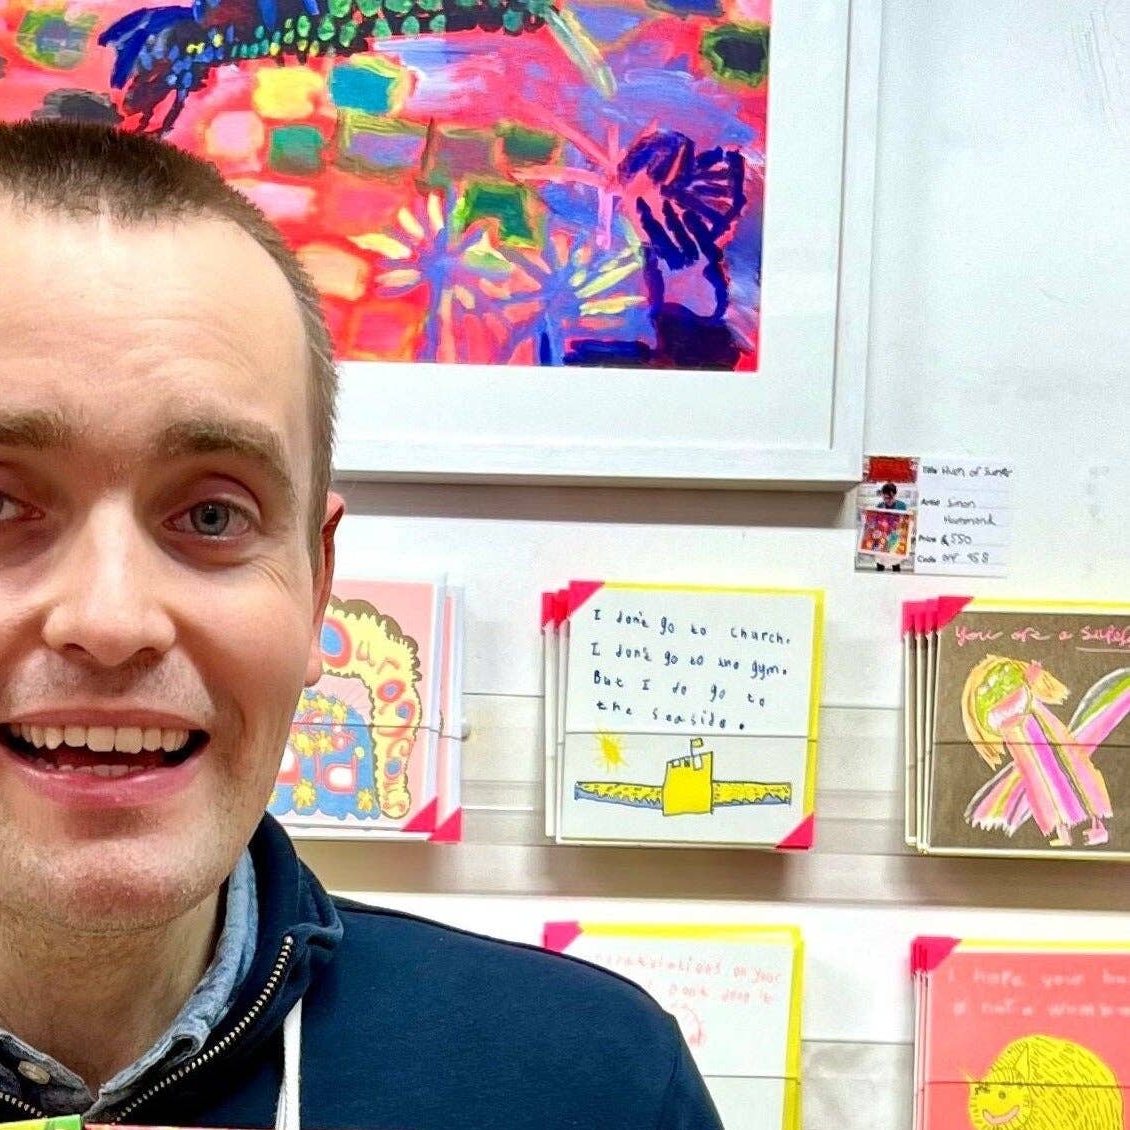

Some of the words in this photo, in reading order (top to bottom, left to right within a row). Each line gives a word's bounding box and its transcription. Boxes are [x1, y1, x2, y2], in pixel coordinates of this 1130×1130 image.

[594, 609, 601, 621] I
[661, 616, 675, 636] go
[691, 624, 707, 636] to
[591, 642, 601, 656] I
[664, 651, 679, 667] go
[690, 654, 704, 666] to
[750, 660, 788, 680] gym.
[594, 670, 624, 688] But
[642, 679, 650, 691] I
[672, 682, 687, 696] do
[710, 682, 726, 702] go
[747, 692, 765, 708] to
[596, 700, 632, 716] the
